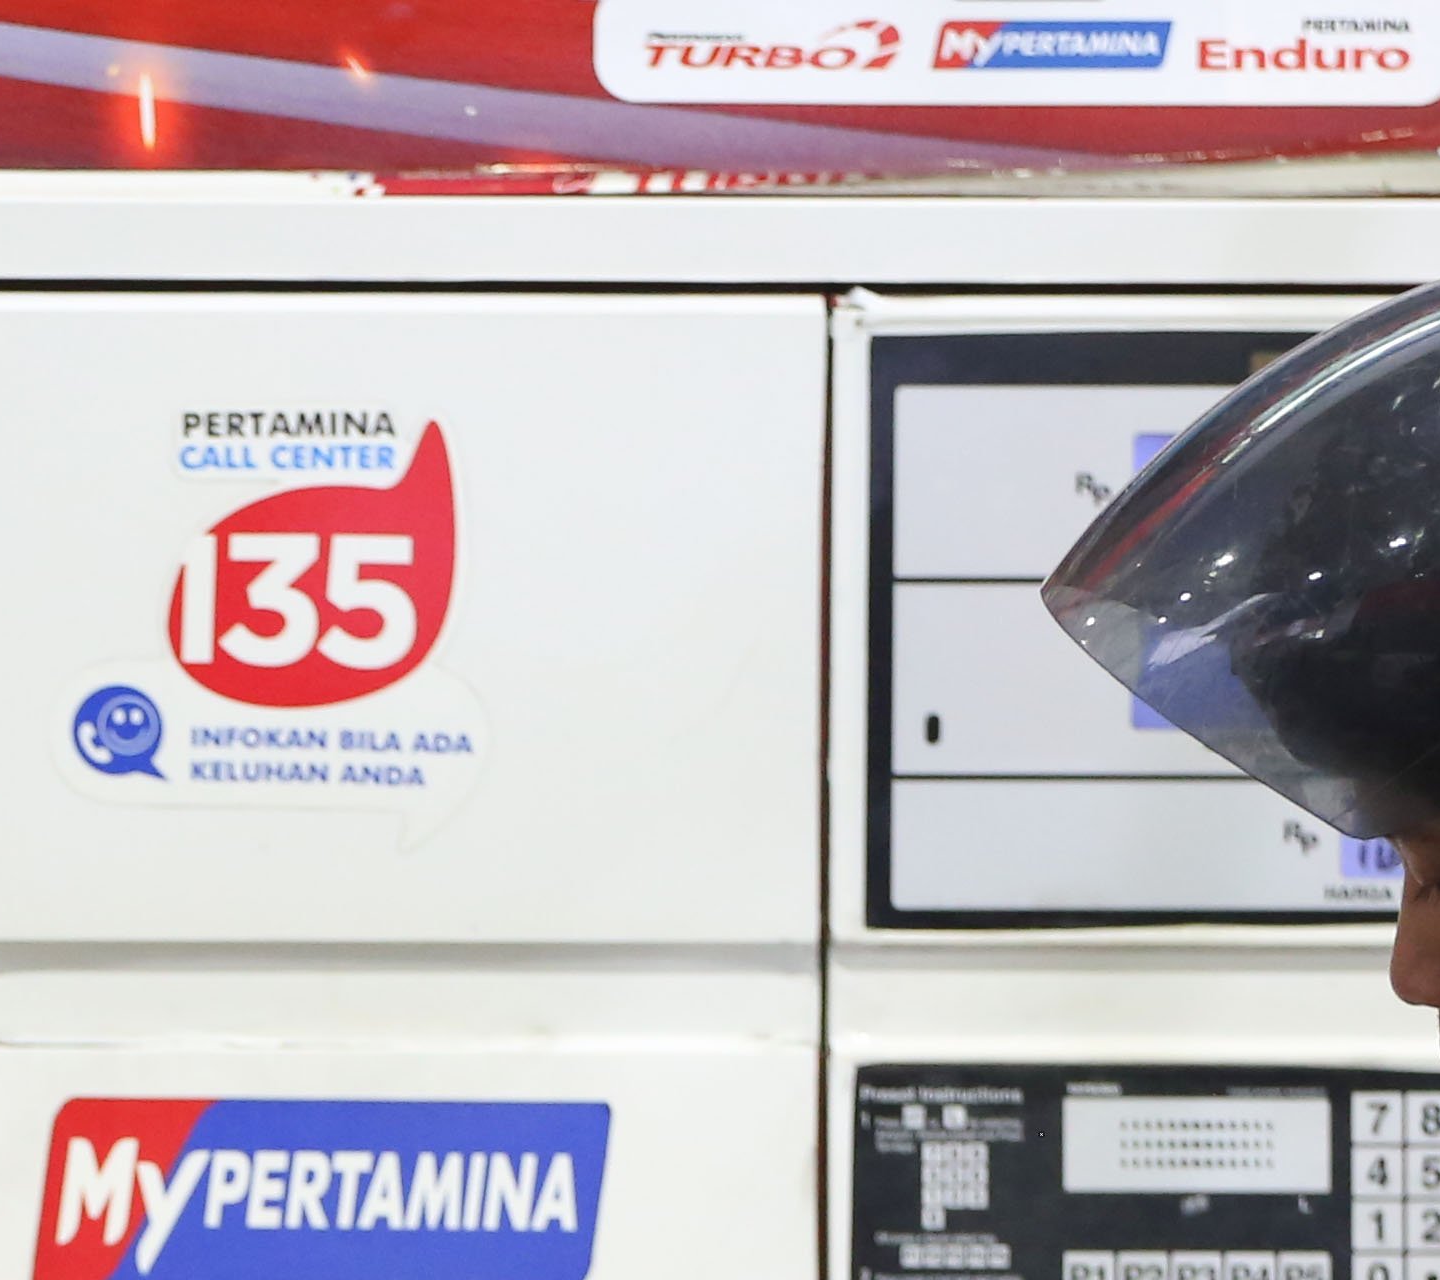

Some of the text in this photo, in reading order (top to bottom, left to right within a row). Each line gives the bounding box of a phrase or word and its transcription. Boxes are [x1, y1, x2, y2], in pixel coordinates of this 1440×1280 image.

[646, 46, 855, 69] TURBO
[1197, 39, 1410, 71] Enduro
[182, 411, 396, 437] PERTAMINA
[179, 445, 395, 469] CALL CENTER
[179, 532, 419, 670] 135
[190, 726, 473, 753] INFOKAN BILA ADA
[190, 760, 426, 785] KELUHAN ANDA
[1368, 1102, 1388, 1134] 7
[1369, 1157, 1388, 1187] 4
[54, 1136, 579, 1276] MyPERTAMINA
[1370, 1210, 1384, 1241] 1
